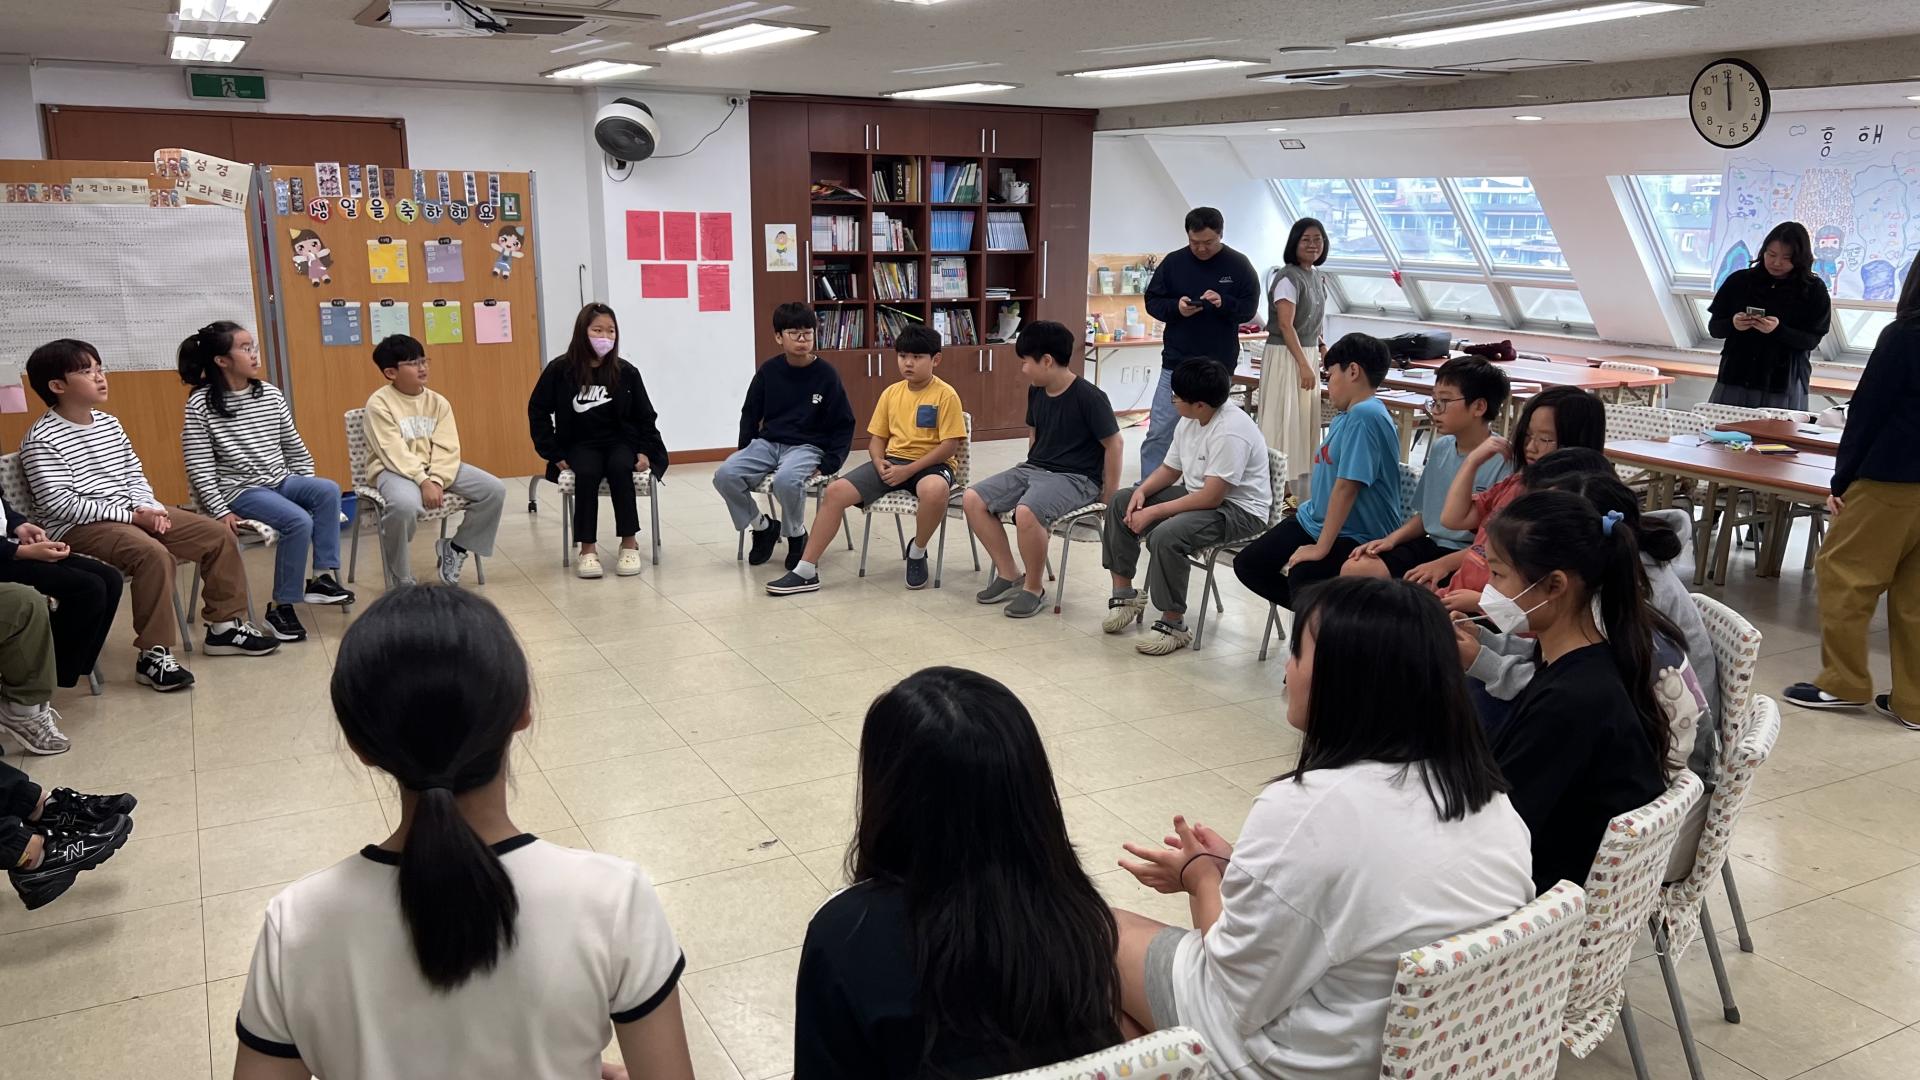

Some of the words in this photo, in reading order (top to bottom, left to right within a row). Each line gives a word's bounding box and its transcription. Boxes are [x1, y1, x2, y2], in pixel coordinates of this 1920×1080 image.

[1723, 69, 1732, 79] 12
[1739, 73, 1743, 82] 1
[1711, 75, 1718, 84] 11
[1702, 86, 1712, 96] 10
[1748, 82, 1755, 91] 2
[1700, 101, 1707, 111] 9
[1754, 97, 1760, 107] 3
[1706, 116, 1713, 125] 8
[1750, 113, 1757, 122] 4
[1717, 125, 1723, 135] 7
[1729, 128, 1735, 137] 6
[1742, 123, 1749, 132] 5
[231, 634, 248, 645] N
[146, 665, 159, 677] N
[66, 840, 84, 862] N
